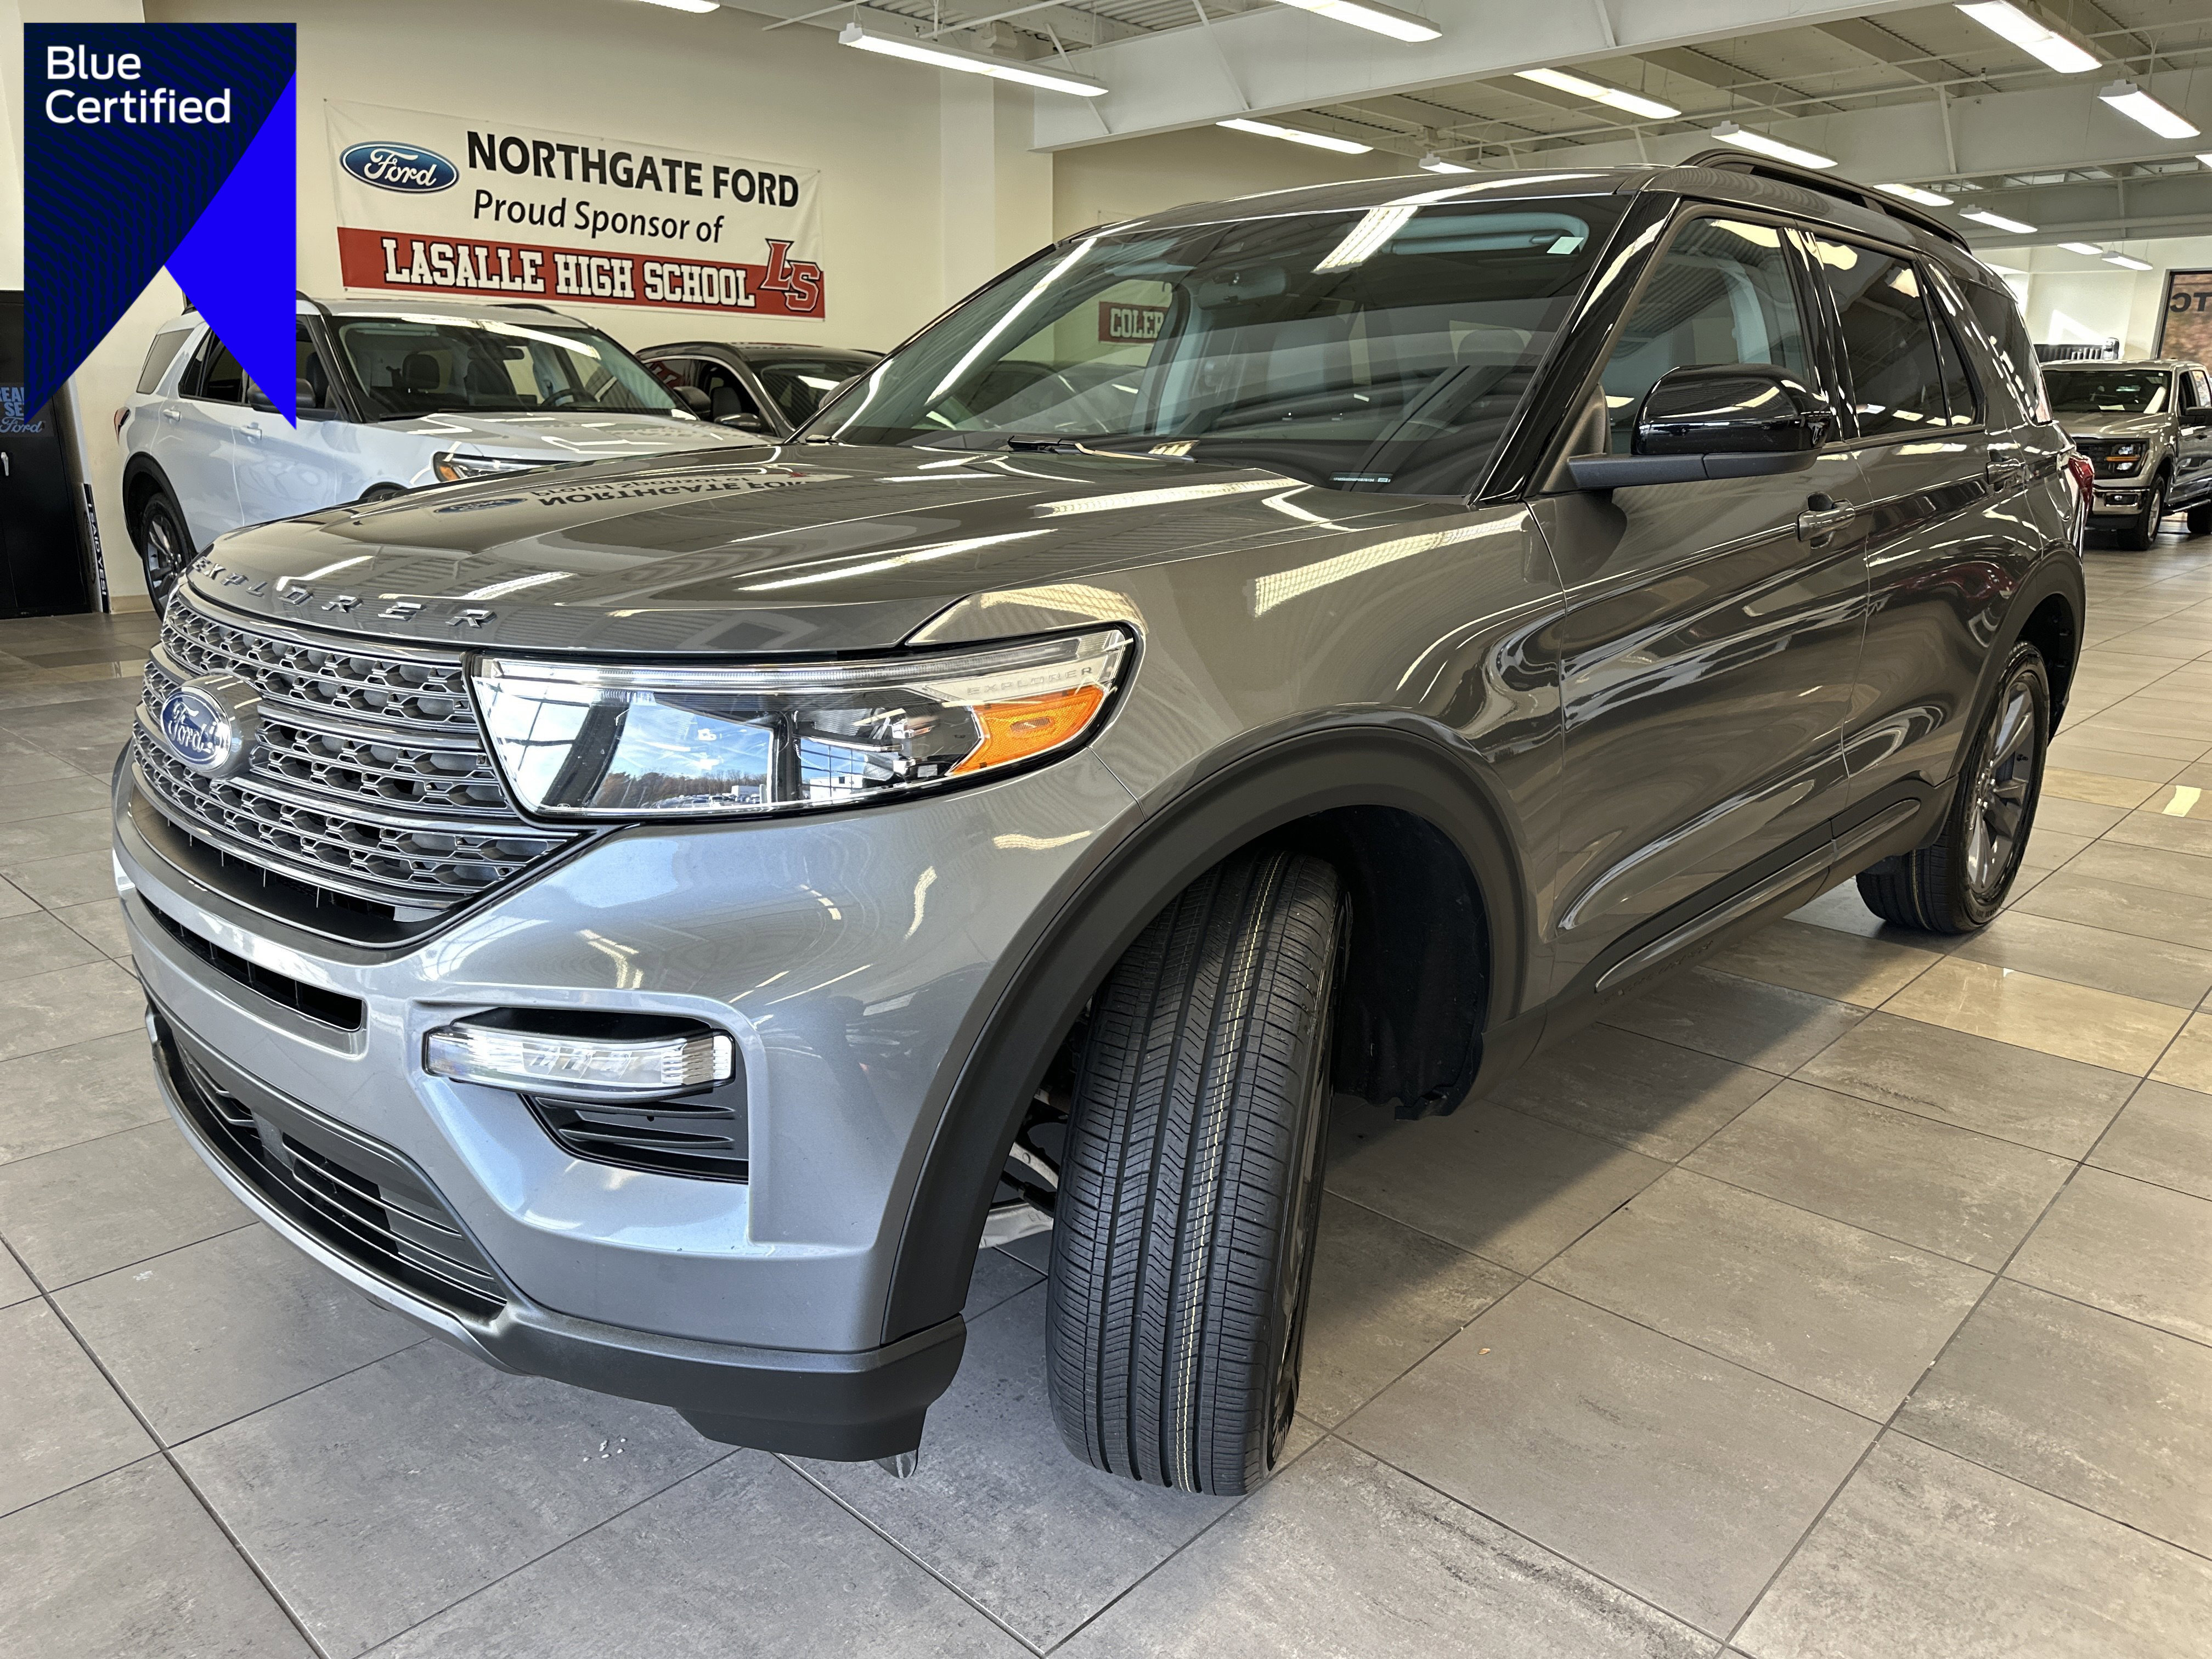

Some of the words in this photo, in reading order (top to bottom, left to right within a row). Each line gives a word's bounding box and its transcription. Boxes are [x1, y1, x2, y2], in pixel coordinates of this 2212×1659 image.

[364, 148, 437, 187] Ford
[467, 131, 703, 196] NORTHGATE
[713, 165, 798, 208] FORD
[473, 189, 567, 228] Proud
[574, 200, 690, 239] Sponsor
[696, 215, 725, 243] of
[381, 236, 546, 294] LASALLE
[553, 252, 635, 300] HIGH
[642, 260, 756, 307] SCHOOL
[758, 238, 821, 313] LS
[191, 555, 499, 629] EXPLORER
[966, 666, 1093, 695] EXPLORER
[167, 701, 208, 753] Ford
